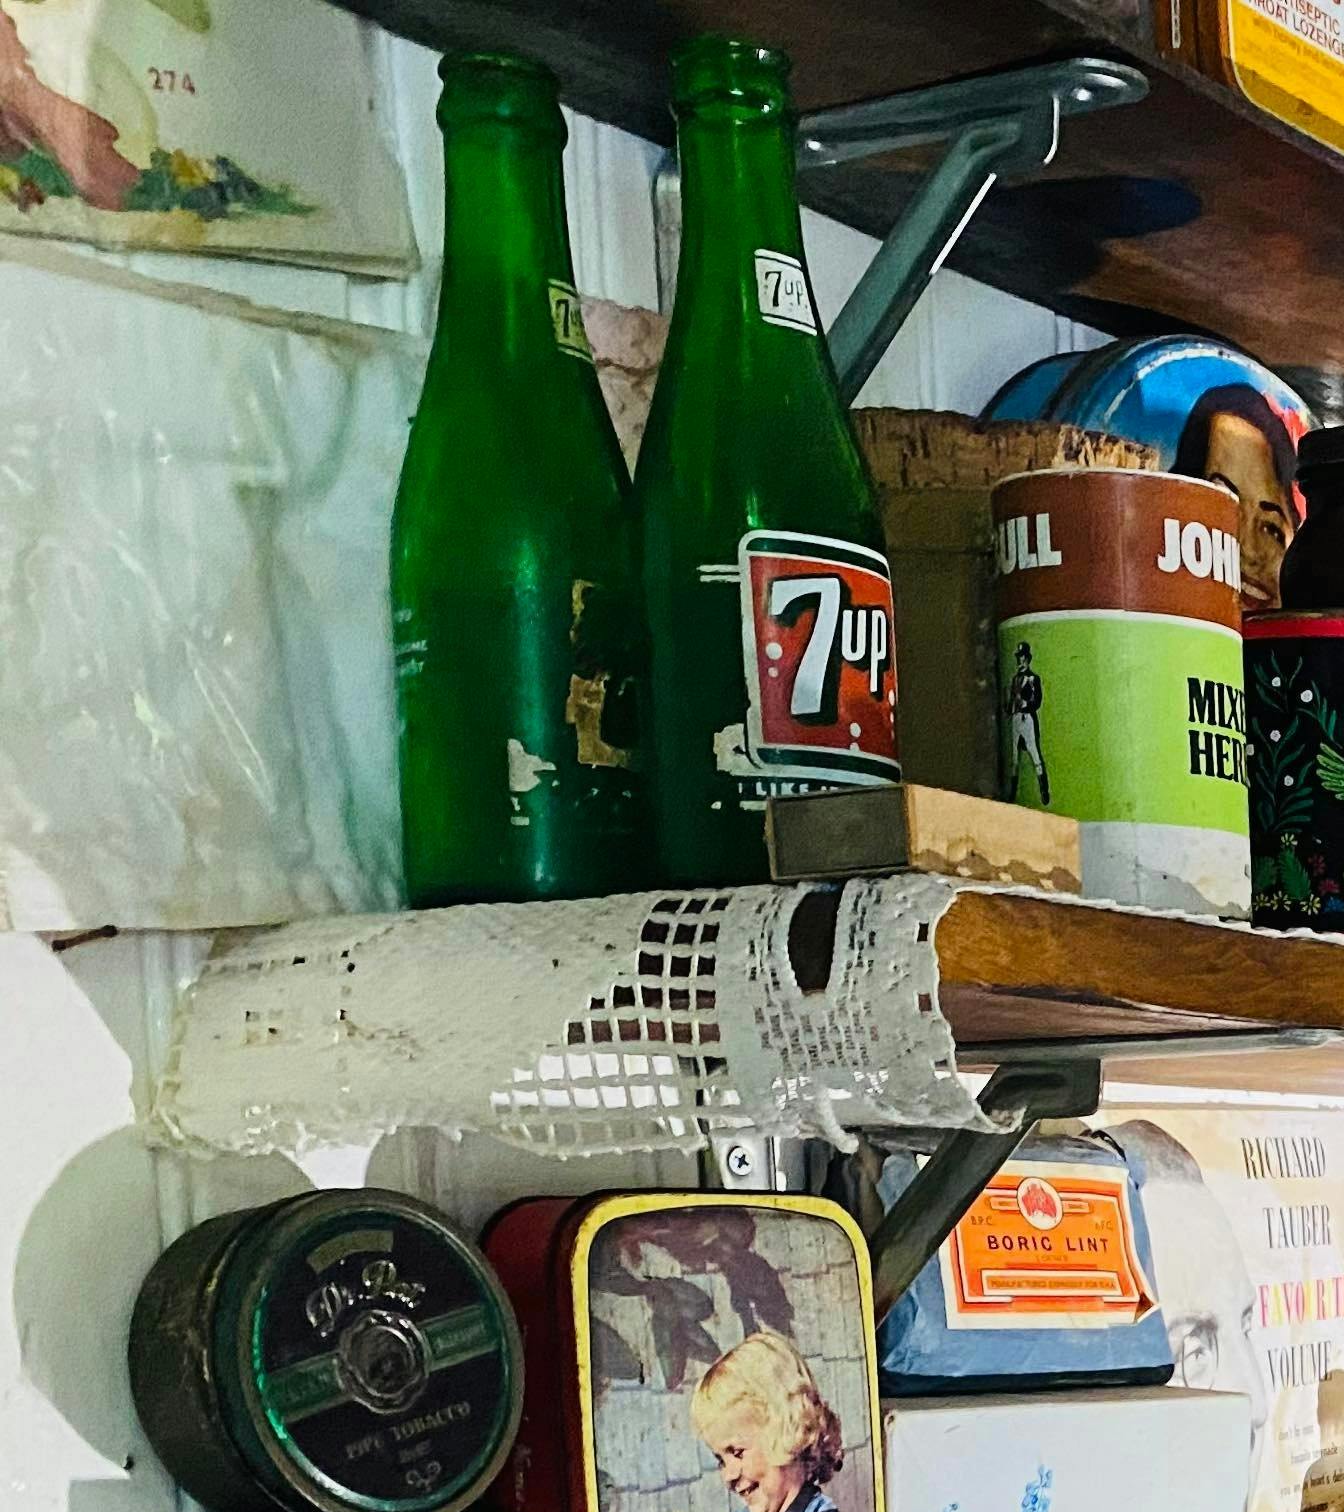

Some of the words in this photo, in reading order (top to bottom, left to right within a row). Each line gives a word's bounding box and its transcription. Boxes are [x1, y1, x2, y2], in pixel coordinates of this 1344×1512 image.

[148, 66, 195, 94] 274
[1240, 1136, 1327, 1181] RICHARD
[987, 1235, 1052, 1252] BORIC
[1066, 1237, 1110, 1254] LINT
[1263, 1204, 1331, 1249] TAUBER
[1267, 1340, 1334, 1392] VOLUME
